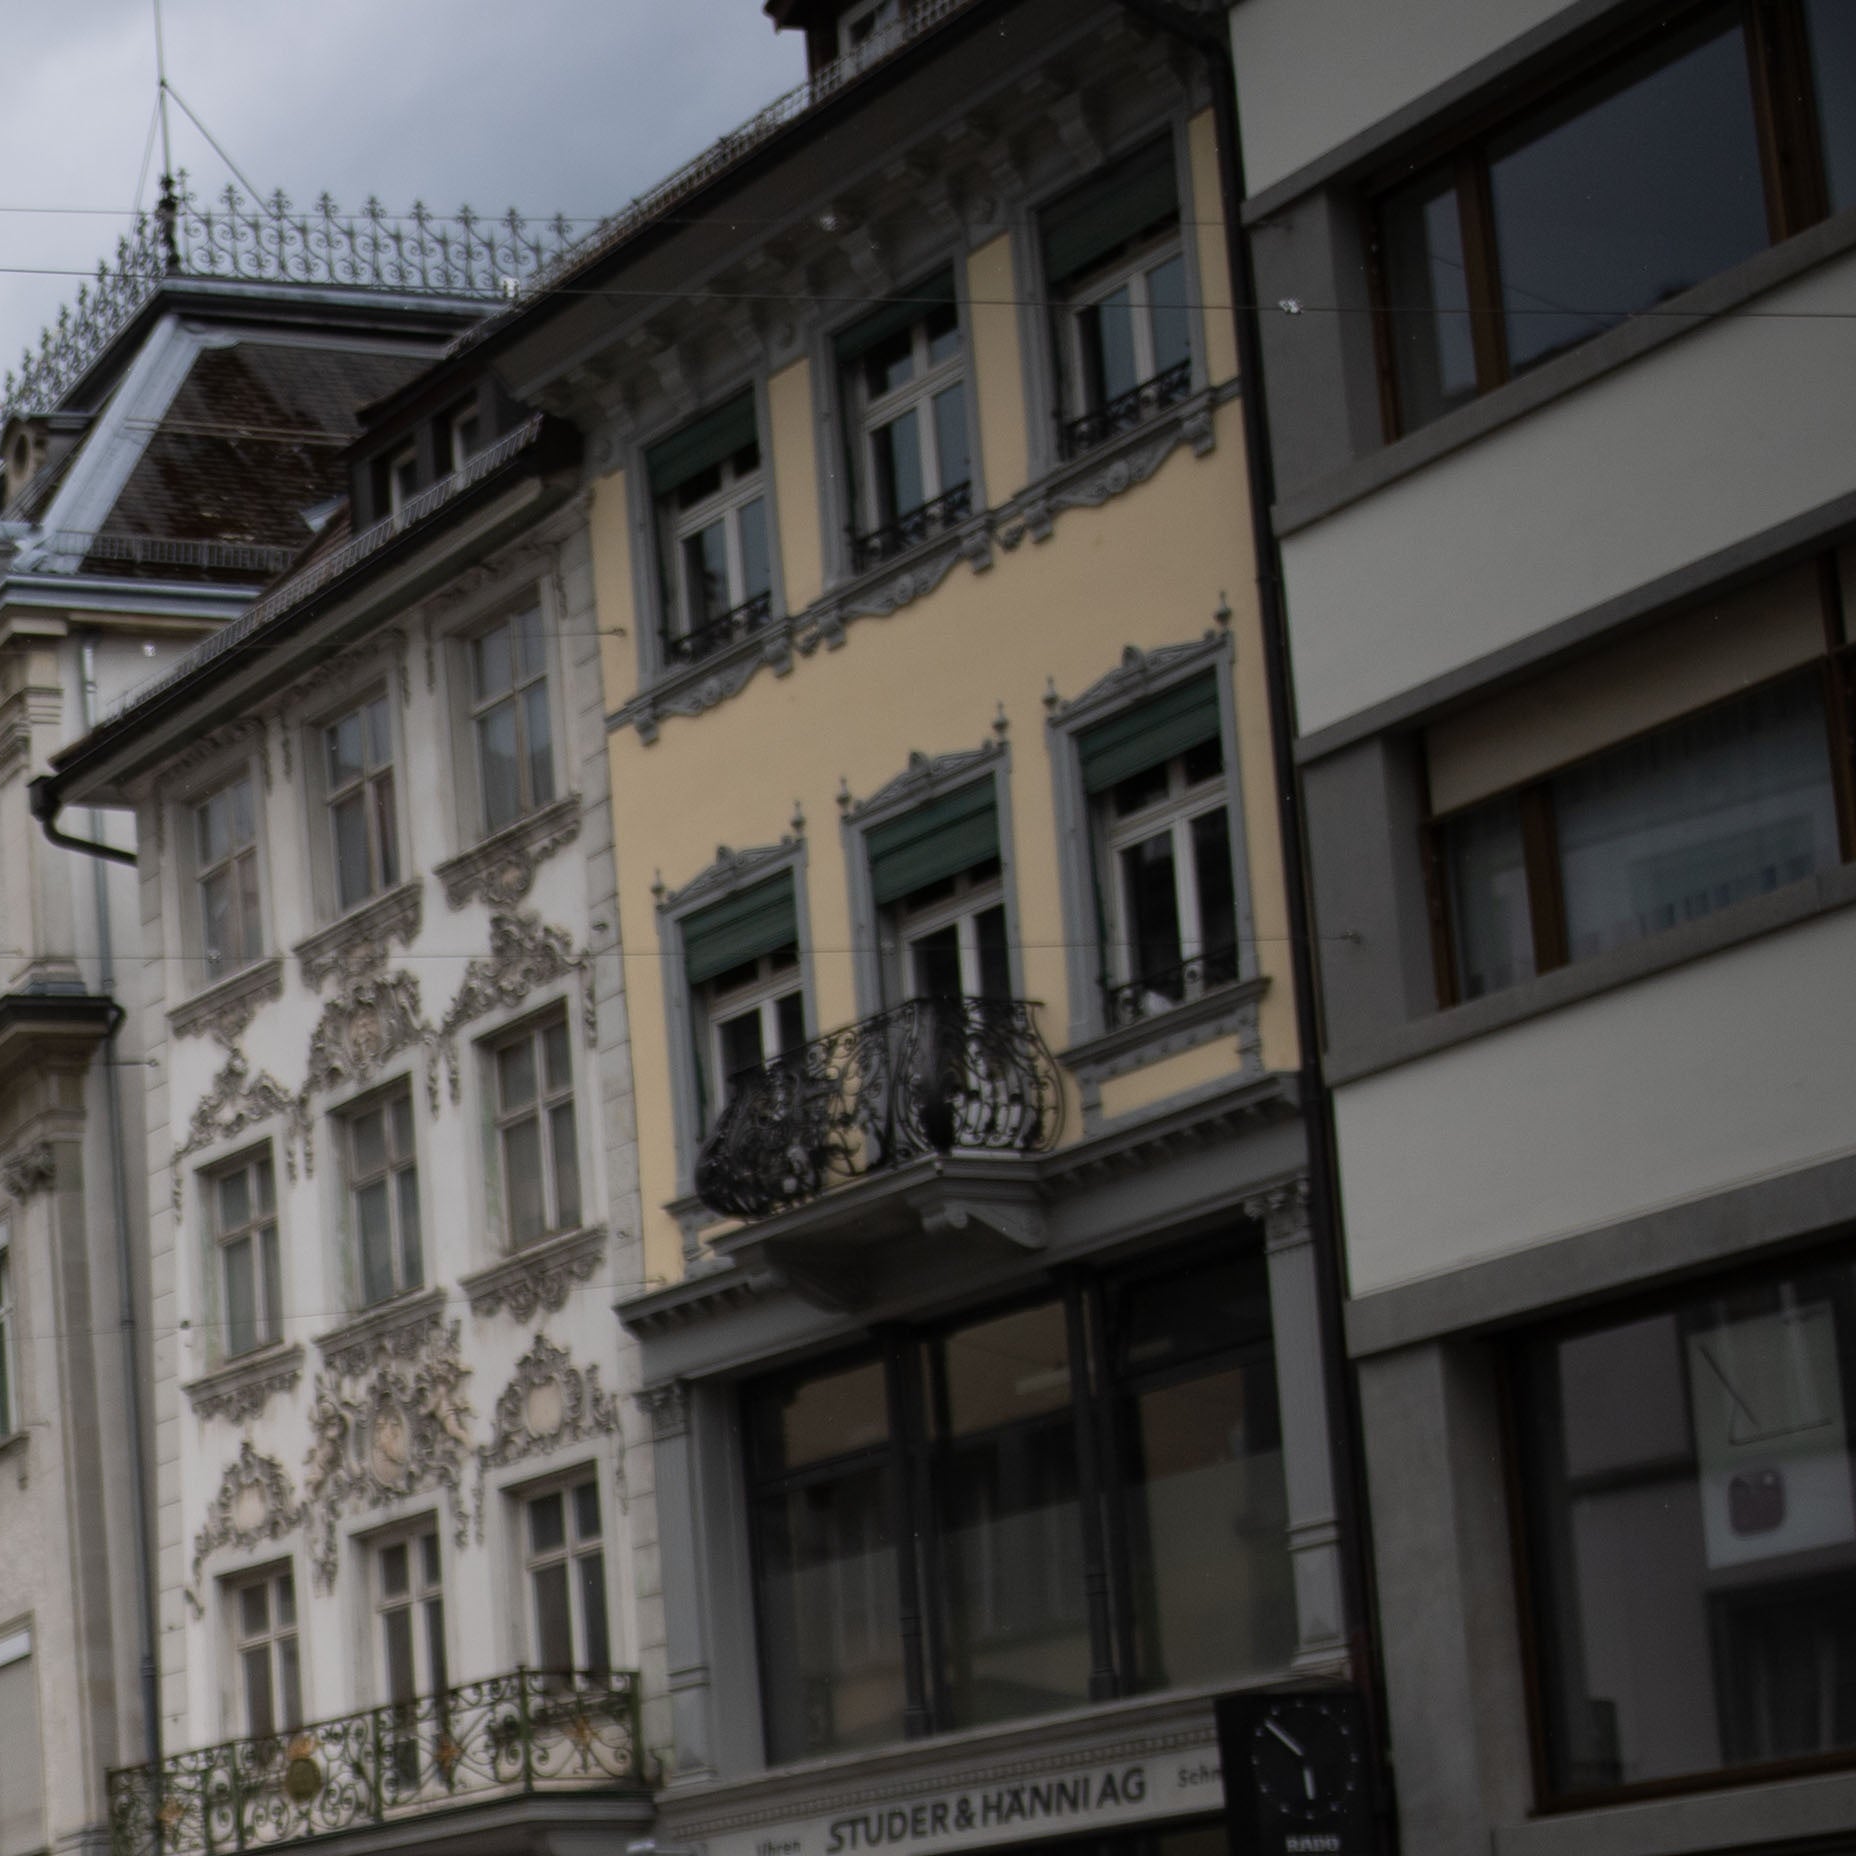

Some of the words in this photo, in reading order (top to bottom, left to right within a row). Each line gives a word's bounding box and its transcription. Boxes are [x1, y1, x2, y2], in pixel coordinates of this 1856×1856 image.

[826, 1803, 949, 1854] STUDER
[954, 1804, 974, 1830] &
[981, 1780, 1090, 1828] HÄNNI
[1096, 1767, 1146, 1809] AG
